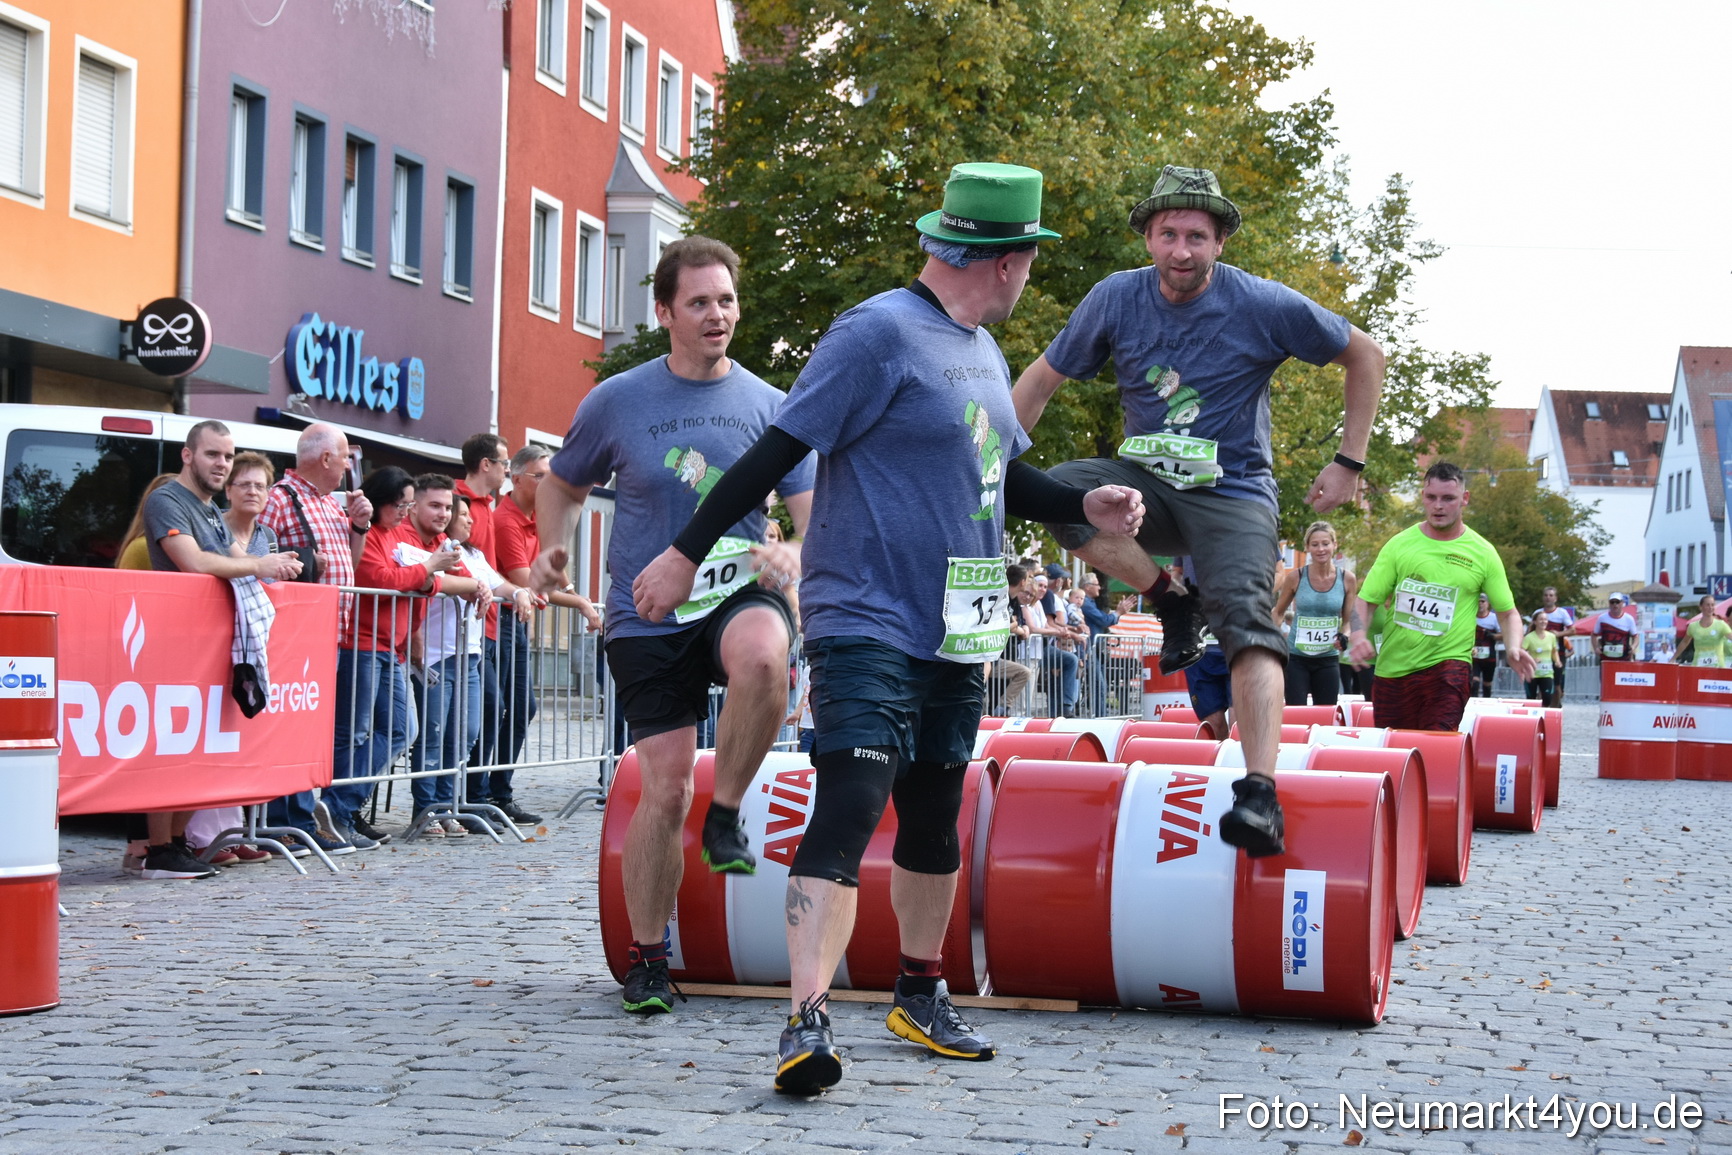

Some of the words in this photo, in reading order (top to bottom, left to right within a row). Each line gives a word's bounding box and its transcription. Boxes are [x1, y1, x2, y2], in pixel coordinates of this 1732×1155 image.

[958, 218, 978, 230] Irish.
[138, 346, 198, 357] hunkemöller
[295, 312, 400, 414] Eilles
[648, 419, 678, 440] póg
[683, 416, 705, 429] mo
[709, 414, 749, 434] thóin
[1126, 436, 1208, 459] BOCK
[703, 563, 738, 590] 10
[953, 562, 1006, 587] BOC
[1401, 581, 1451, 600] BOCK
[1408, 597, 1440, 618] 144
[1300, 618, 1336, 628] BOCK
[1408, 616, 1434, 630] CHRIS
[954, 633, 1006, 652] MATTHIAS
[1306, 631, 1330, 642] 145
[21, 690, 47, 698] energie
[265, 679, 320, 714] ergie
[1283, 937, 1291, 974] energie
